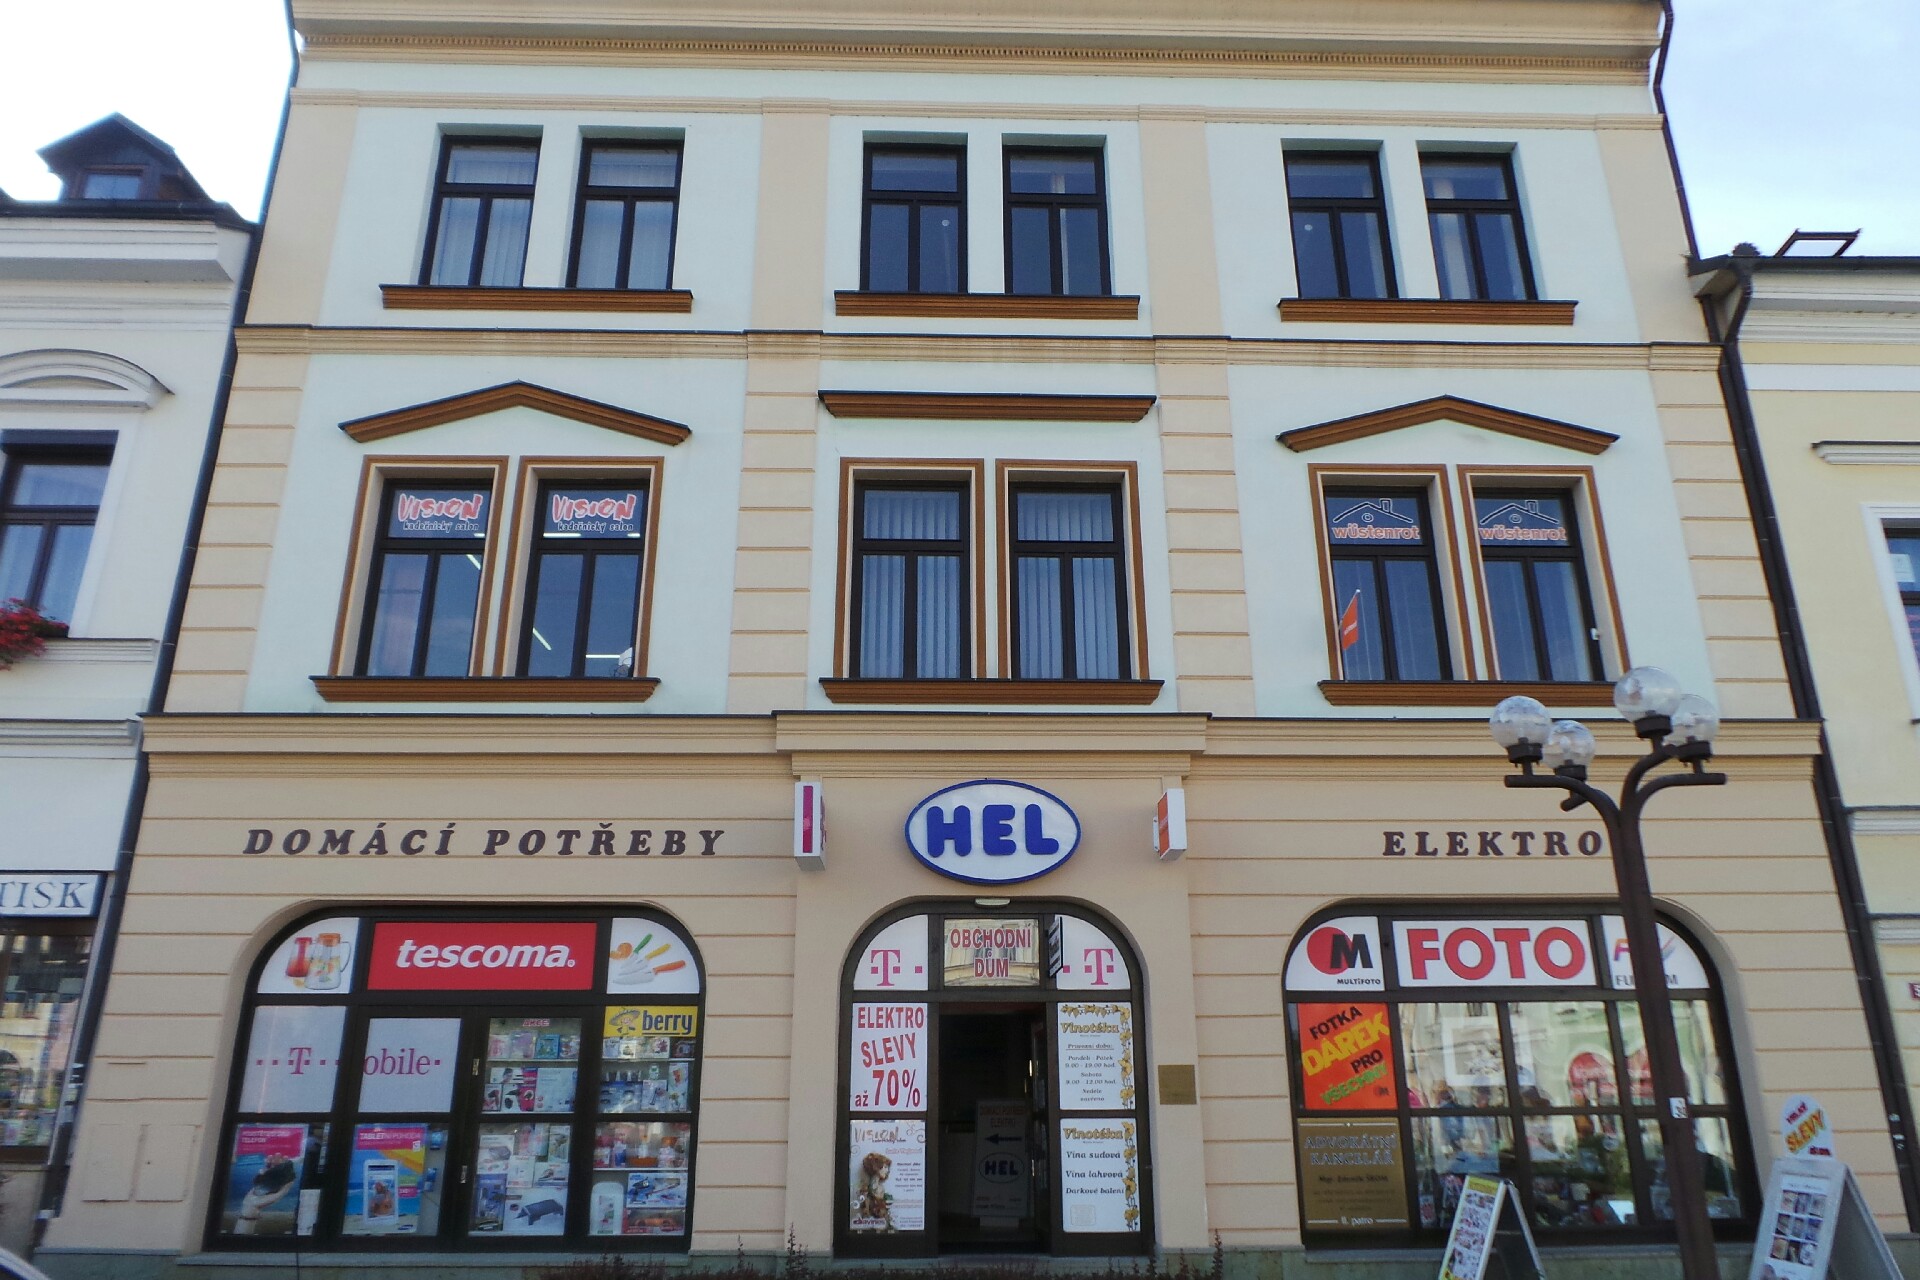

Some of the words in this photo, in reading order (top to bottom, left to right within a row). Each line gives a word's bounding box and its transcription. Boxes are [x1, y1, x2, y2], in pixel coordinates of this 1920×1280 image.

[398, 493, 483, 522] VISION
[552, 493, 637, 522] VISION
[454, 521, 479, 531] salon
[609, 521, 634, 531] salon
[1332, 524, 1420, 540] wüstenrot
[1479, 525, 1567, 541] wüstenrot
[243, 822, 456, 855] DOMÁCÍ
[483, 822, 725, 856] POTŘEBY
[926, 803, 1060, 858] HEL
[1383, 830, 1603, 856] ELEKTRO
[950, 928, 1031, 949] OBCHODNÍ
[396, 939, 570, 969] tescoma
[974, 950, 1010, 978] DŮM
[1406, 926, 1586, 981] FOTO
[642, 1010, 693, 1035] berry
[857, 1007, 925, 1029] ELEKTRO
[1309, 1006, 1363, 1041] FOTKA
[860, 1032, 916, 1068] SLEVY
[1302, 1011, 1391, 1077] DÁREK
[363, 1048, 430, 1076] obile
[1350, 1049, 1384, 1075] PRO
[854, 1090, 869, 1107] až
[872, 1069, 921, 1108] 70%
[1304, 1133, 1397, 1149] ADVOKÁTNÍ
[984, 1160, 1018, 1176] HEL
[1310, 1149, 1394, 1165] KANCELÁŘ
